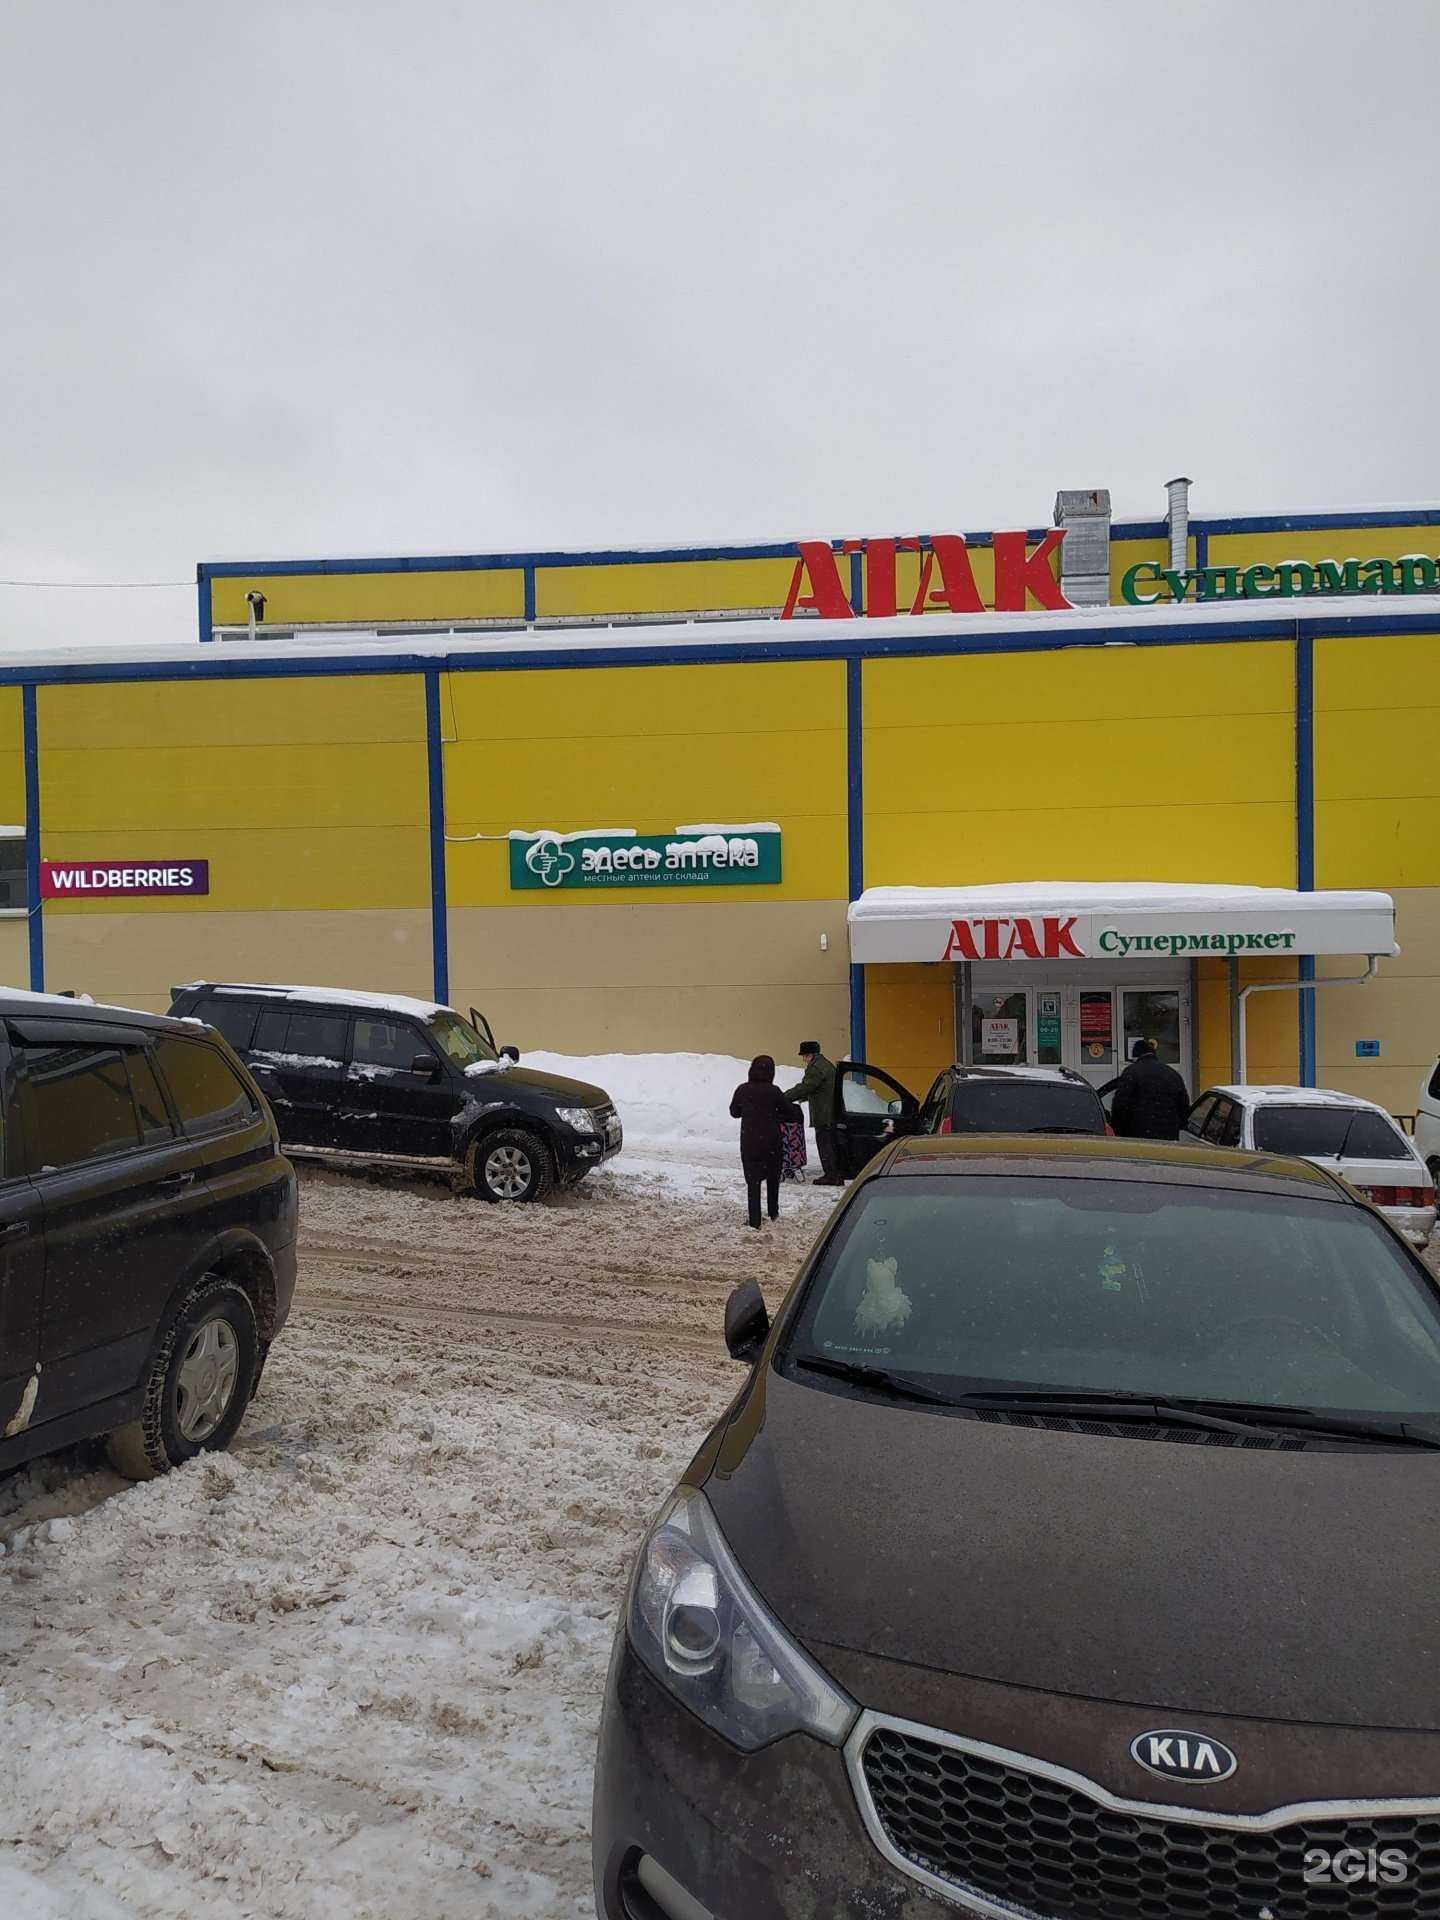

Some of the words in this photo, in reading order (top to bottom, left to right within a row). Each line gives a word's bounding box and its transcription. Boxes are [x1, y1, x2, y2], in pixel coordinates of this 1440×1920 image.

[780, 530, 1075, 620] АТАК
[1121, 555, 1440, 605] Супермар
[581, 847, 662, 873] здесь
[665, 838, 759, 868] аптека
[51, 868, 194, 888] WILDBERRIES
[584, 874, 626, 882] местные
[628, 872, 661, 881] аптеки
[675, 871, 709, 880] склада
[943, 917, 1086, 960] АТАК
[1099, 929, 1296, 957] Супермаркет
[1149, 1737, 1220, 1774] KIA
